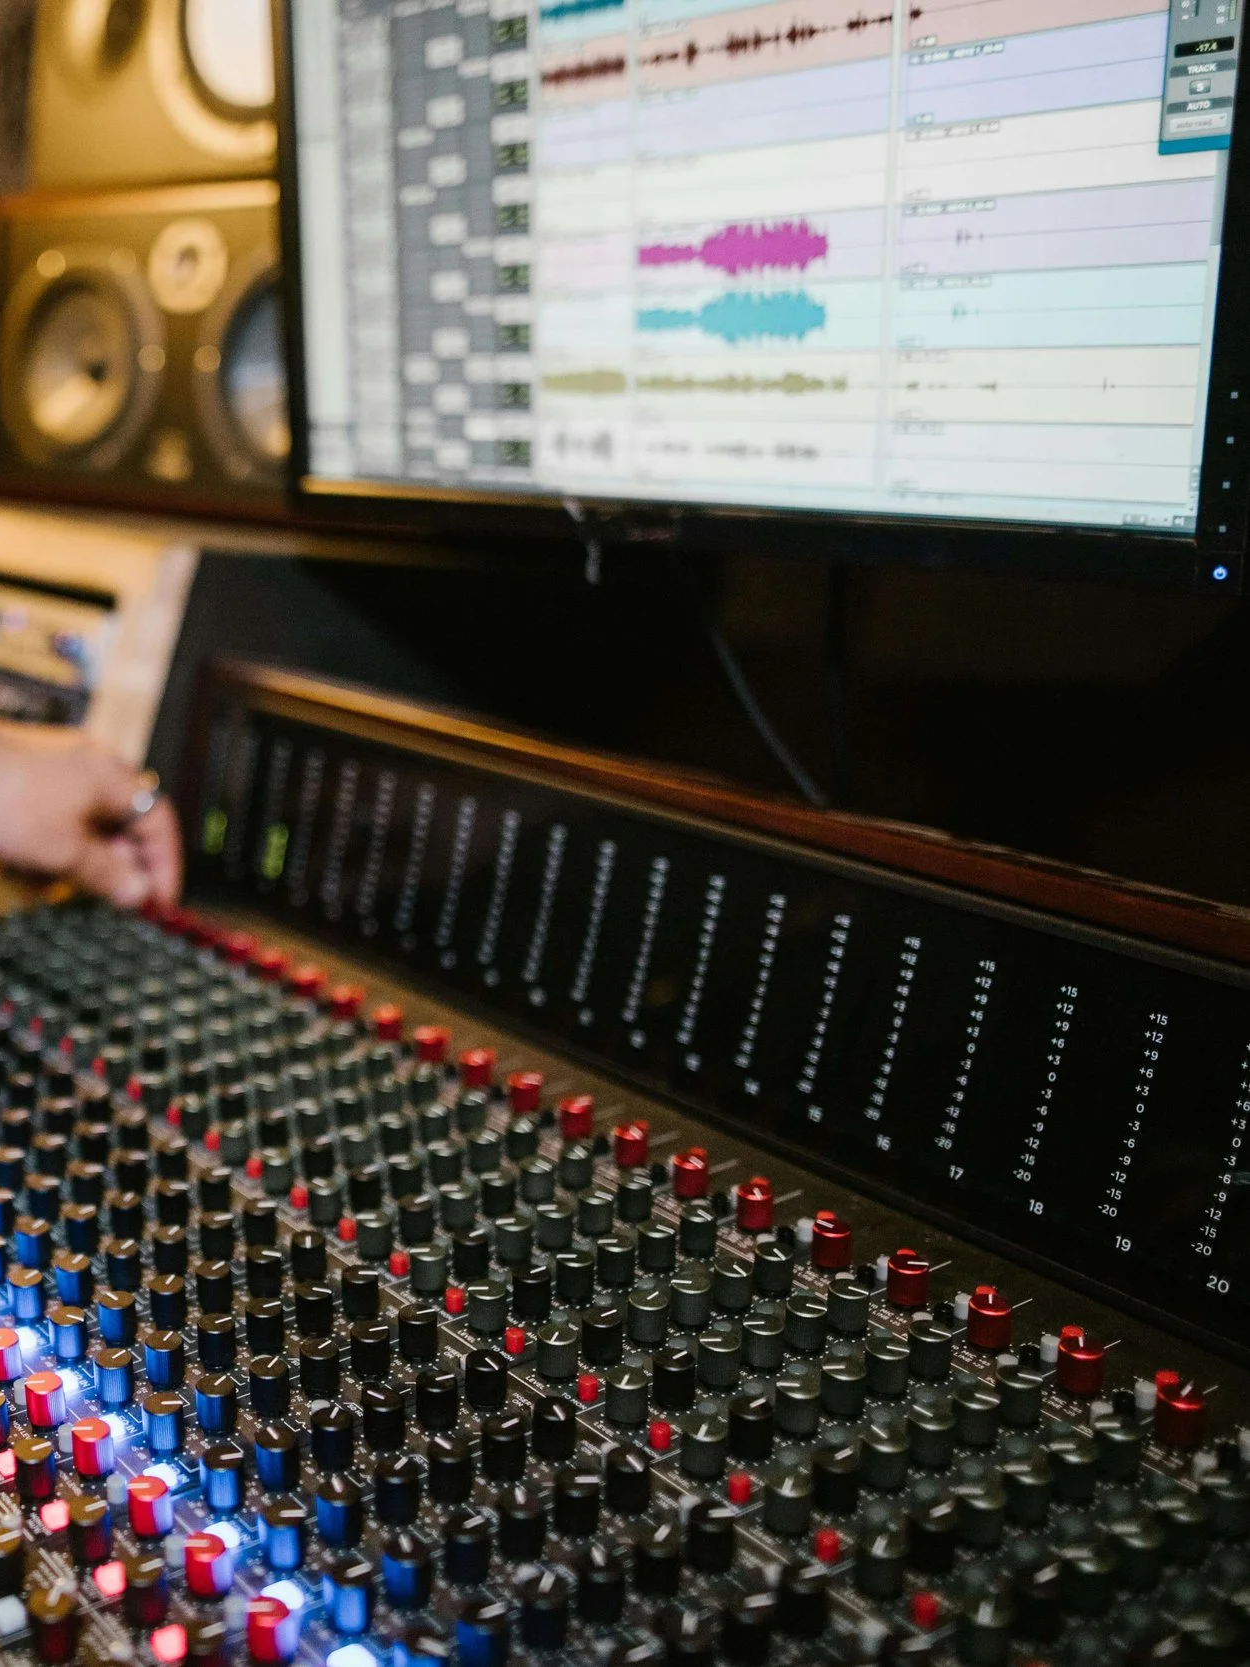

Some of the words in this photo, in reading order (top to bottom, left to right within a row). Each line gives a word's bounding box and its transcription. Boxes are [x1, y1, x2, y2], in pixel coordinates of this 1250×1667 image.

[1187, 63, 1216, 74] TRACK
[1186, 100, 1211, 111] AUTO
[1061, 986, 1078, 998] +15
[1056, 1004, 1074, 1016] +12
[1150, 1013, 1168, 1026] +15
[1056, 1022, 1069, 1032] +9
[1145, 1031, 1163, 1044] +12
[1051, 1039, 1064, 1049] +6
[1144, 1050, 1158, 1062] +9
[1139, 1068, 1154, 1079] +6
[1135, 1085, 1149, 1097] +3
[1136, 1104, 1144, 1114] 0
[1236, 1100, 1250, 1112] +6
[1128, 1122, 1140, 1132] -3
[1231, 1118, 1246, 1130] +3
[877, 1135, 891, 1152] 16
[1124, 1139, 1135, 1150] -6
[1232, 1138, 1241, 1148] 0
[1119, 1156, 1131, 1167] -9
[1224, 1156, 1236, 1168] -3
[950, 1166, 964, 1181] 17
[1013, 1170, 1031, 1182] -20
[1110, 1172, 1126, 1184] -12
[1218, 1174, 1232, 1185] -6
[1106, 1188, 1122, 1201] -15
[1214, 1192, 1226, 1203] -9
[1029, 1199, 1044, 1216] 18
[1098, 1204, 1118, 1218] -20
[1204, 1208, 1222, 1222] -12
[1200, 1226, 1217, 1239] -15
[1115, 1236, 1132, 1252] 19
[1191, 1243, 1212, 1256] -20
[1206, 1275, 1230, 1294] 20
[443, 1348, 455, 1359] ON
[444, 1345, 463, 1359] INSER
[953, 1349, 972, 1362] LINE
[961, 1347, 976, 1359] MIC
[525, 1376, 545, 1390] LEVEL
[512, 1399, 523, 1407] ON
[570, 1398, 587, 1413] MON
[124, 1422, 137, 1434] IN
